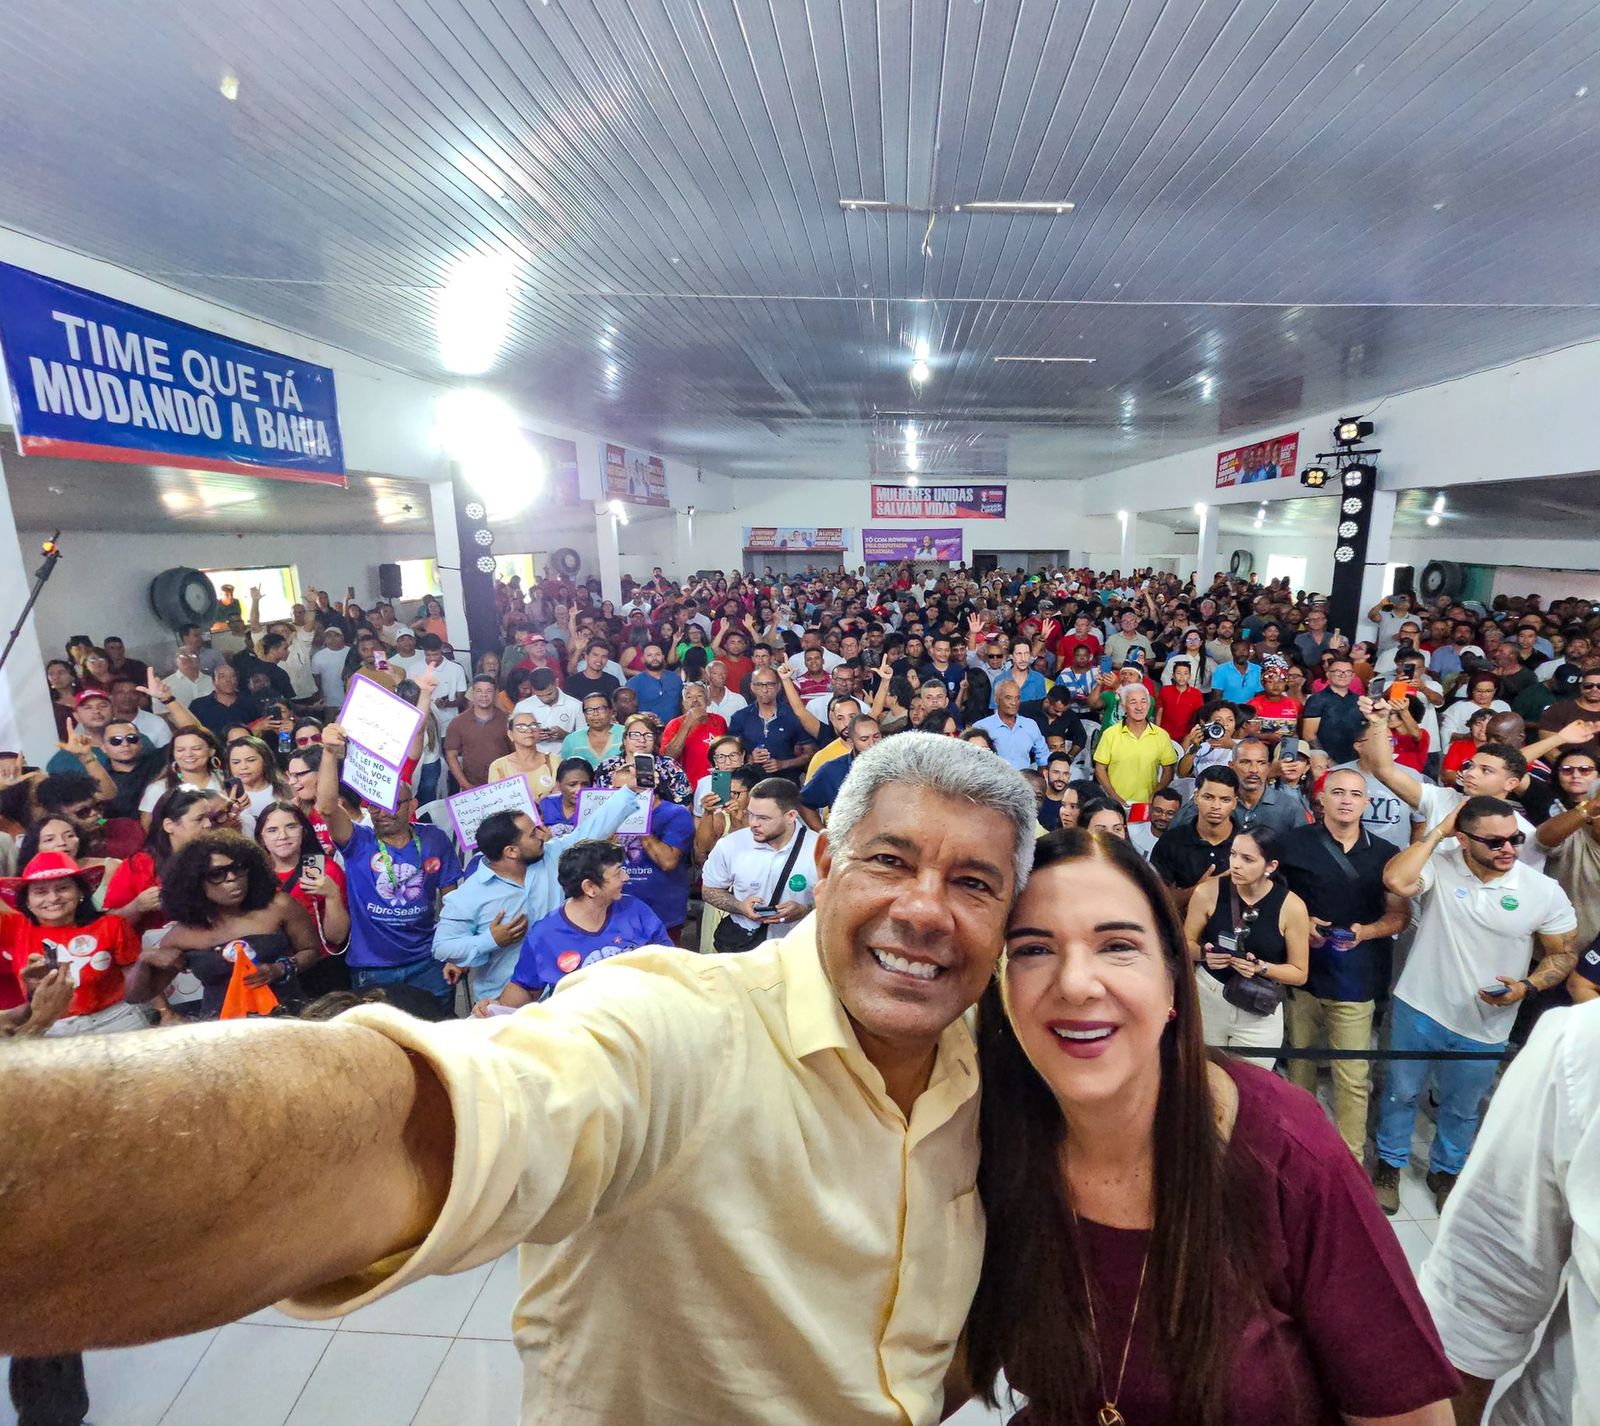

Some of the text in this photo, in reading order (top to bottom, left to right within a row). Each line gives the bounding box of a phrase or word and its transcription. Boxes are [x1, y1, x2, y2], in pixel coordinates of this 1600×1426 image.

[52, 310, 304, 413] TIME QUE TÁ
[29, 356, 332, 457] MUDANDO A BAHIA
[876, 488, 931, 501] MULHERES
[933, 488, 974, 502] UNIDAS
[876, 502, 957, 515] SALVAM VIDAS
[360, 755, 371, 768] LEI
[373, 761, 385, 772] NO
[1368, 797, 1400, 825] YC
[366, 902, 428, 917] FibroSeabra
